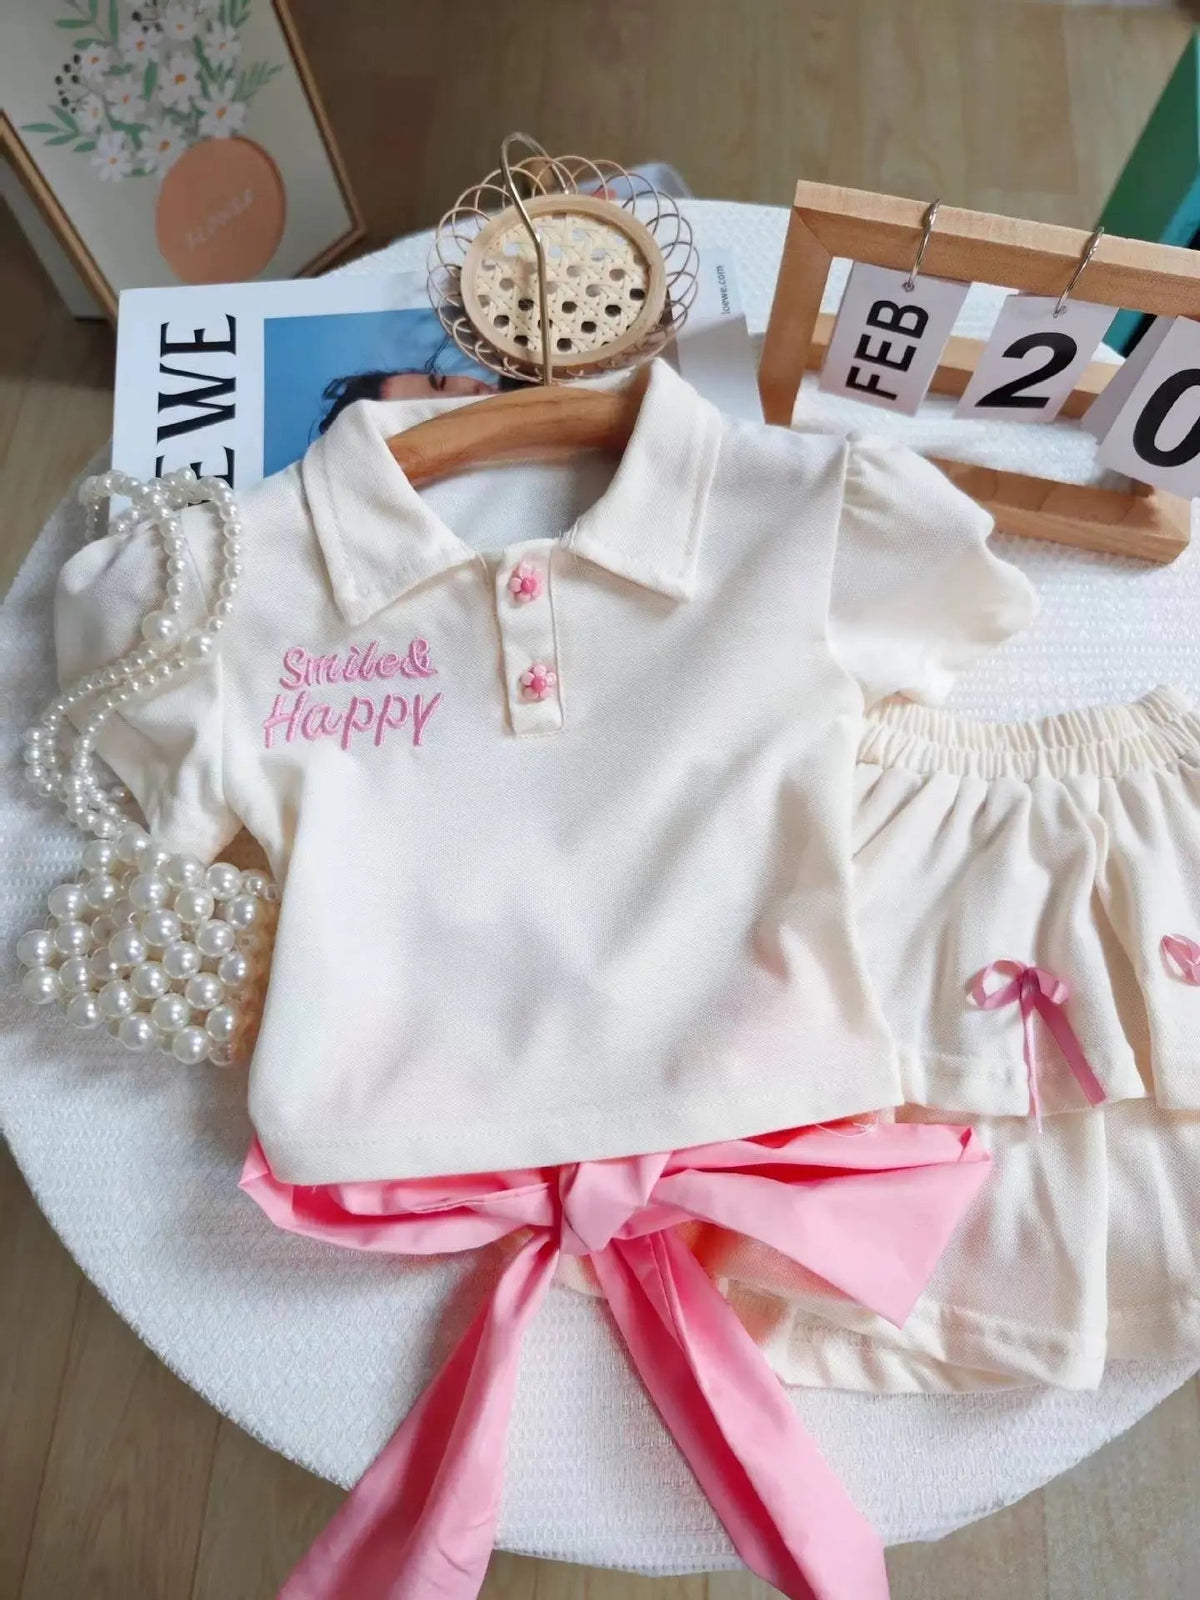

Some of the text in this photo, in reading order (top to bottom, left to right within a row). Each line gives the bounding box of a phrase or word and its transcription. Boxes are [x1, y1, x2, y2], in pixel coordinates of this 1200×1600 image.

[715, 265, 731, 315] loewe.com
[845, 299, 930, 401] FEB
[156, 313, 237, 508] EWE
[263, 690, 443, 751] Happy
